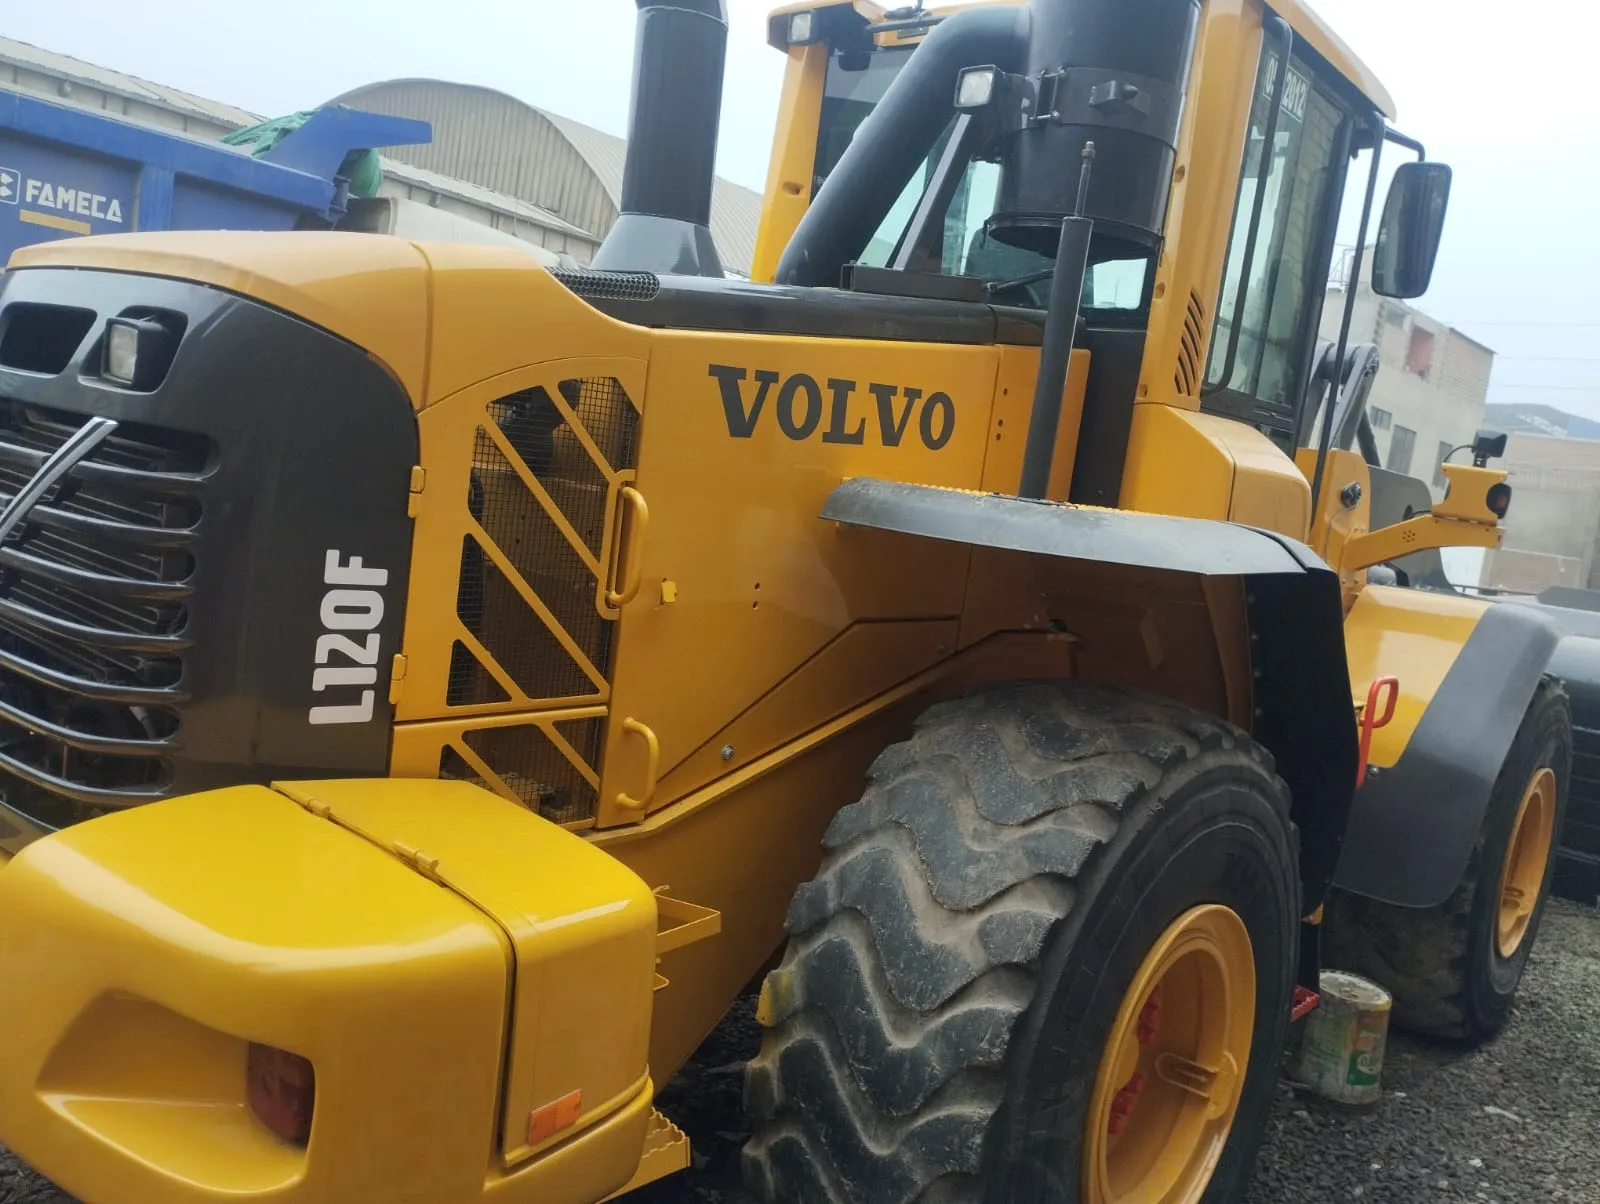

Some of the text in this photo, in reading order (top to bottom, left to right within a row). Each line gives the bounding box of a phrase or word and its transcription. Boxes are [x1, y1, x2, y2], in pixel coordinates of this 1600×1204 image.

[1282, 70, 1306, 118] 2012
[25, 178, 122, 223] FAMECA
[708, 364, 955, 450] VOLVO
[309, 549, 388, 724] L120F
